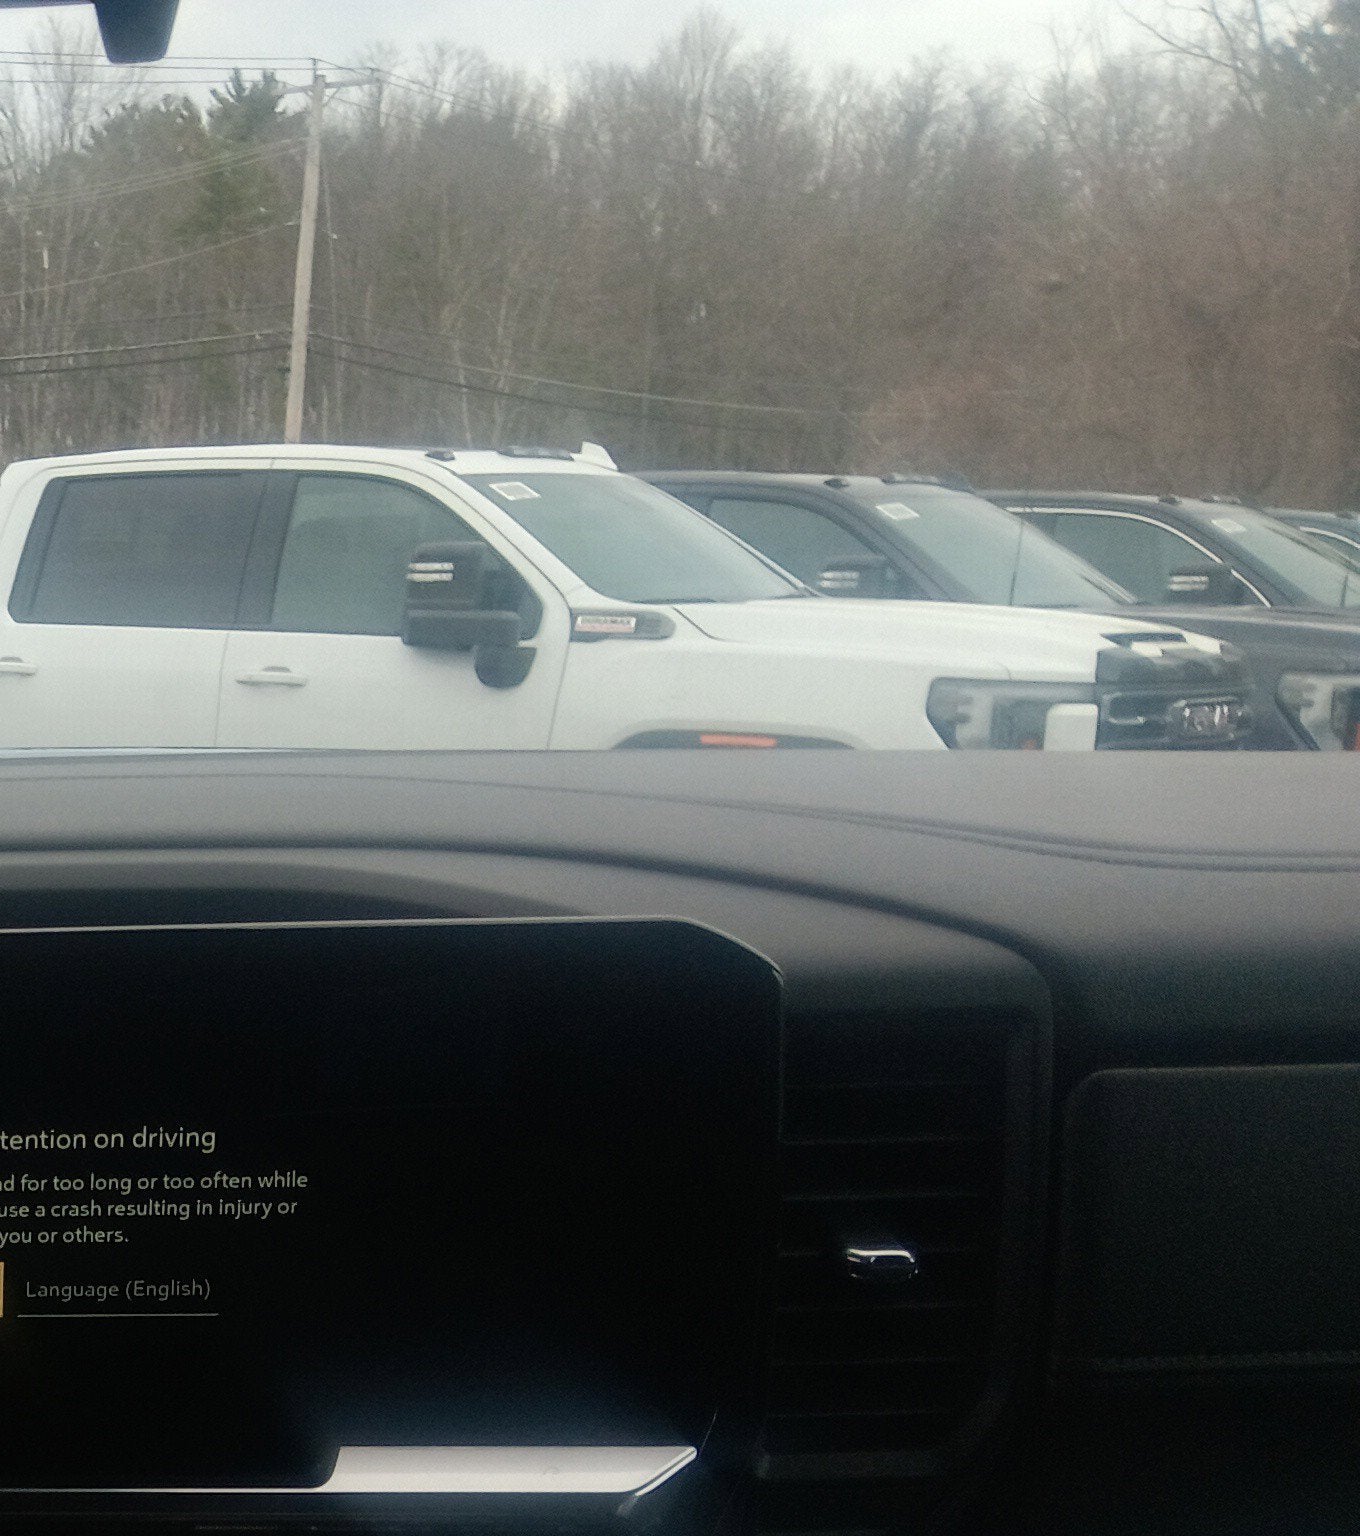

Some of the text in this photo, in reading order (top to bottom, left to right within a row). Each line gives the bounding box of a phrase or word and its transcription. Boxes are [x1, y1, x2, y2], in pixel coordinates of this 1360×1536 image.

[93, 1132, 125, 1149] on
[132, 1125, 217, 1154] driving
[20, 1173, 48, 1192] for
[52, 1174, 85, 1191] too
[90, 1172, 132, 1196] long
[137, 1176, 159, 1190] or
[162, 1174, 195, 1190] too
[199, 1170, 252, 1189] often
[257, 1169, 309, 1189] while
[34, 1205, 47, 1217] a
[50, 1199, 102, 1217] crash
[107, 1198, 191, 1221] resulting
[196, 1199, 213, 1216] in
[218, 1198, 273, 1220] injury
[277, 1200, 298, 1215] or
[37, 1230, 59, 1244] or
[62, 1225, 130, 1244] others.
[26, 1278, 212, 1303] Language (English)
